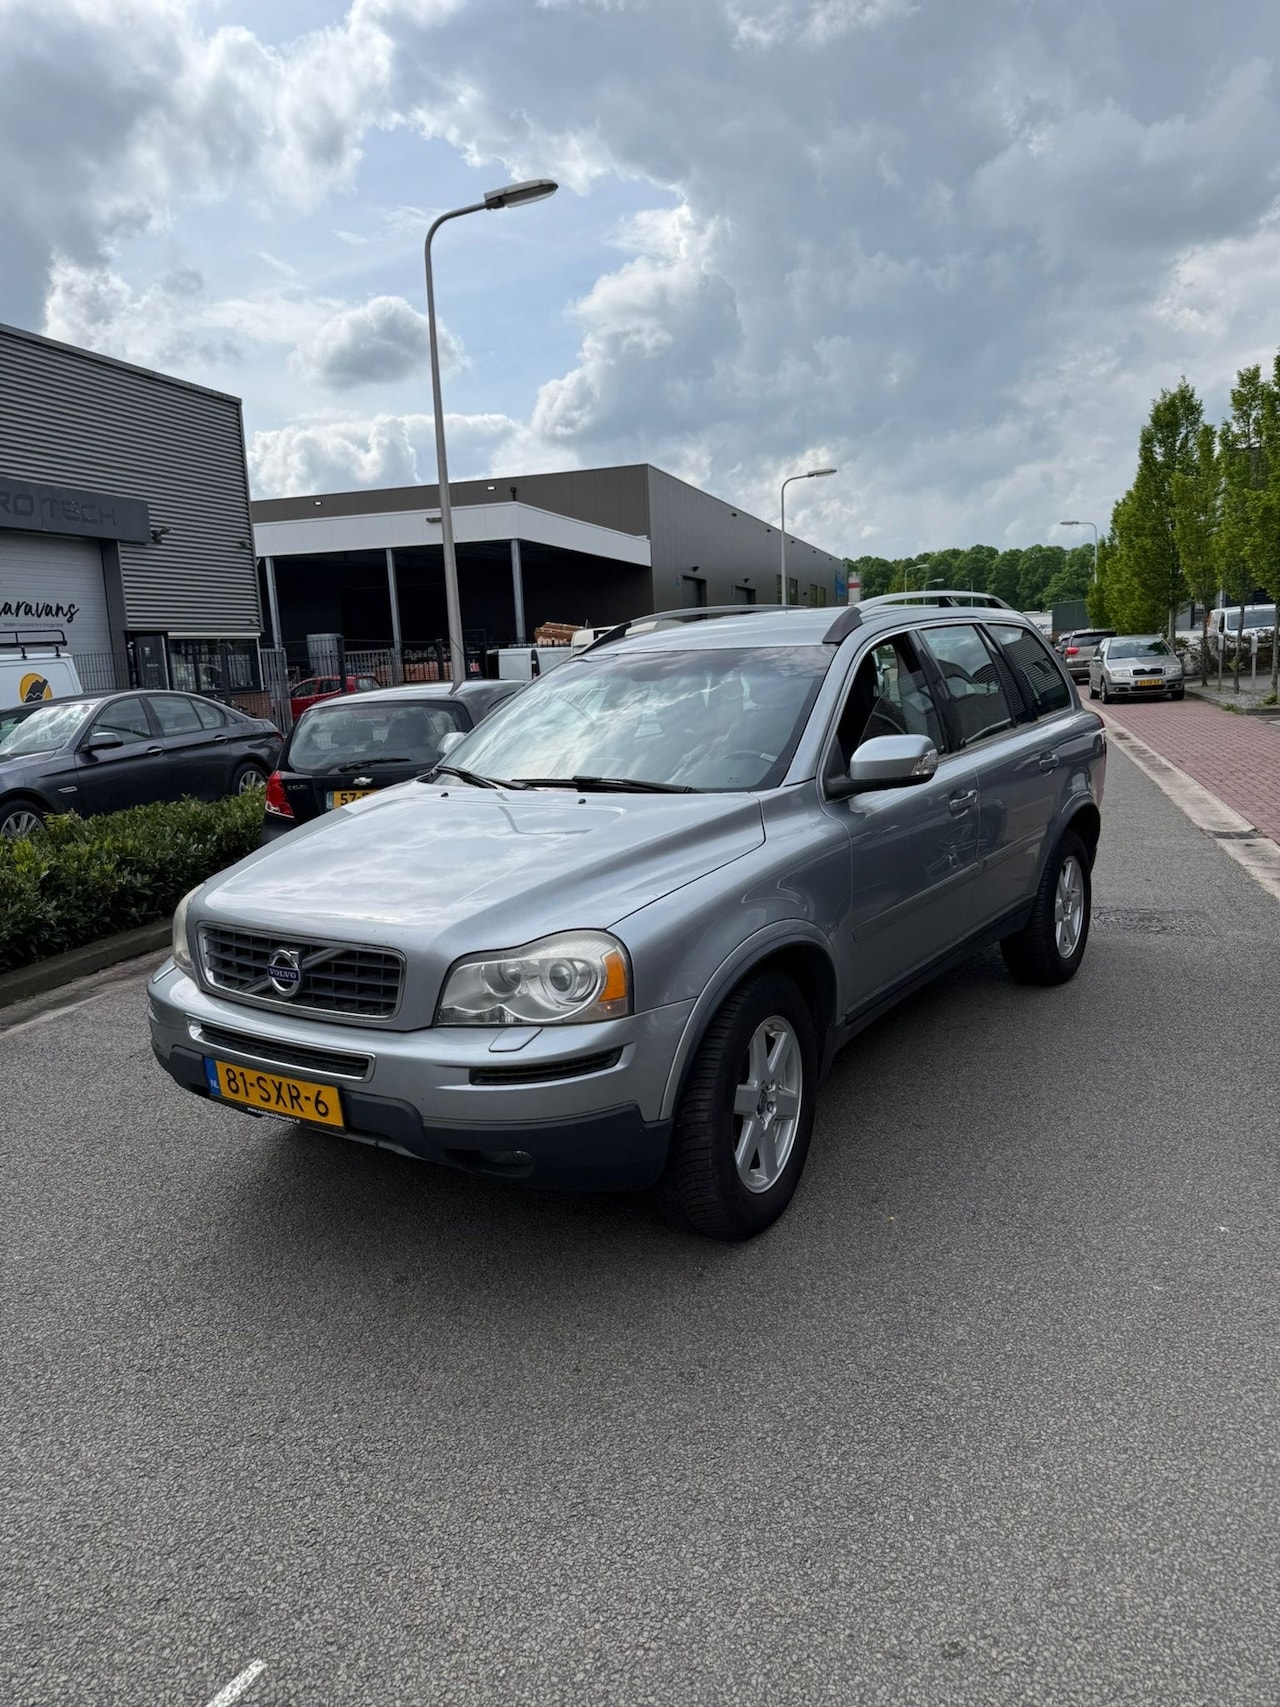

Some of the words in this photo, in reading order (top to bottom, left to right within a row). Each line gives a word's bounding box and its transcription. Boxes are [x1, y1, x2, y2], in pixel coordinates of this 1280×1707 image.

[0, 601, 80, 623] aravans
[269, 968, 297, 979] VOLVO
[210, 1078, 220, 1089] NL
[225, 1067, 329, 1118] 81-SXR-6
